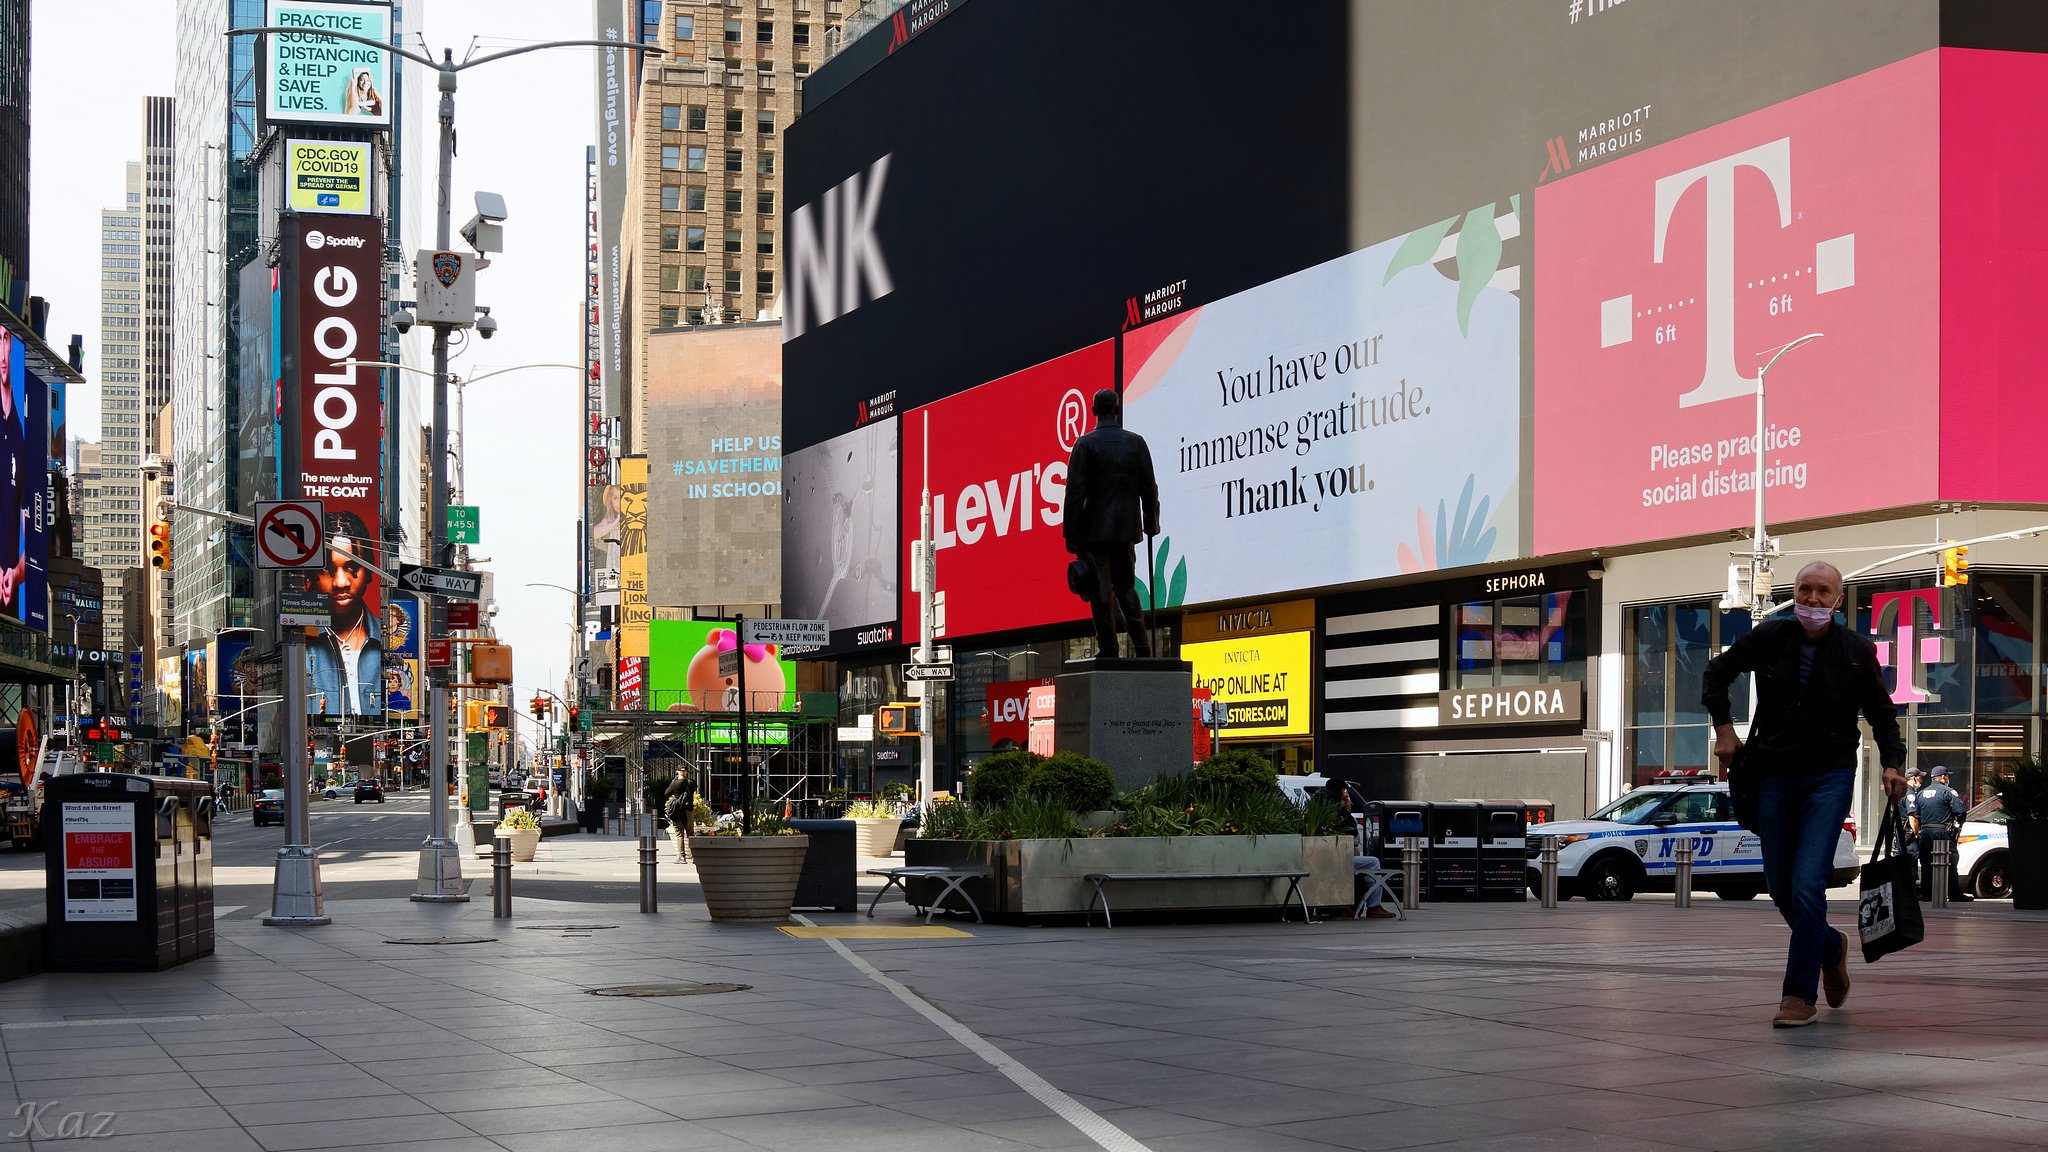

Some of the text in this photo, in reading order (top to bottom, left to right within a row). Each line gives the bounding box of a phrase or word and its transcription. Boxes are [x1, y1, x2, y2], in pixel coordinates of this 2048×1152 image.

[280, 13, 362, 30] PRACTICE
[912, 0, 949, 33] MARQUIS
[280, 30, 340, 45] SOCIAL
[280, 46, 378, 64] DISTANCING
[278, 64, 337, 78] & HELP
[279, 78, 320, 93] SAVE
[279, 96, 328, 110] LIVES.
[1579, 105, 1651, 143] MARRIOTT
[1579, 129, 1642, 162] MARQUIS
[297, 148, 358, 162] CDC.GOV
[297, 160, 358, 174] /COVID19
[326, 236, 364, 248] Spotify
[782, 151, 895, 344] NK
[1144, 280, 1186, 304] MARRIOTT
[612, 245, 621, 372] www.sendinglove.to
[1144, 296, 1181, 318] MARQUIS
[314, 266, 358, 460] POLO G
[1217, 334, 1383, 407] You have our
[870, 390, 896, 407] MARRIOTT
[870, 403, 893, 418] MARQUIS
[1180, 378, 1431, 473] immense gratitude.
[711, 436, 780, 453] HELP US
[1650, 424, 1801, 471] Please practice
[673, 457, 782, 475] #SAVETHEM
[302, 473, 372, 484] The new album
[304, 486, 368, 498] THE GOAT
[689, 483, 706, 498] IN
[1221, 464, 1374, 518] Thank you.
[1642, 474, 1696, 507] social
[411, 573, 470, 590] ONE WAY
[1486, 572, 1545, 592] SEPHORA
[76, 599, 100, 608] WALKER
[624, 591, 647, 605] LION
[622, 606, 650, 623] KING
[1218, 609, 1273, 632] INVICTA
[753, 622, 790, 631] PEDESTRIAN
[792, 623, 808, 631] FLOW
[858, 626, 888, 645] swatch
[1224, 650, 1260, 664] INVICTA
[620, 666, 639, 680] MAMA
[620, 674, 640, 690] MAKES
[1228, 674, 1270, 695] ONLINE
[1273, 672, 1287, 692] AT
[1452, 689, 1564, 719] SEPHORA
[109, 716, 126, 726] NEWS
[1226, 705, 1286, 722] STORES.COM
[88, 729, 118, 739] ESN
[877, 750, 895, 760] swatch
[74, 834, 123, 844] EMBRACE
[1602, 830, 1626, 838] POLICE
[1658, 837, 1714, 858] NPD
[78, 857, 120, 867] ABSURD
